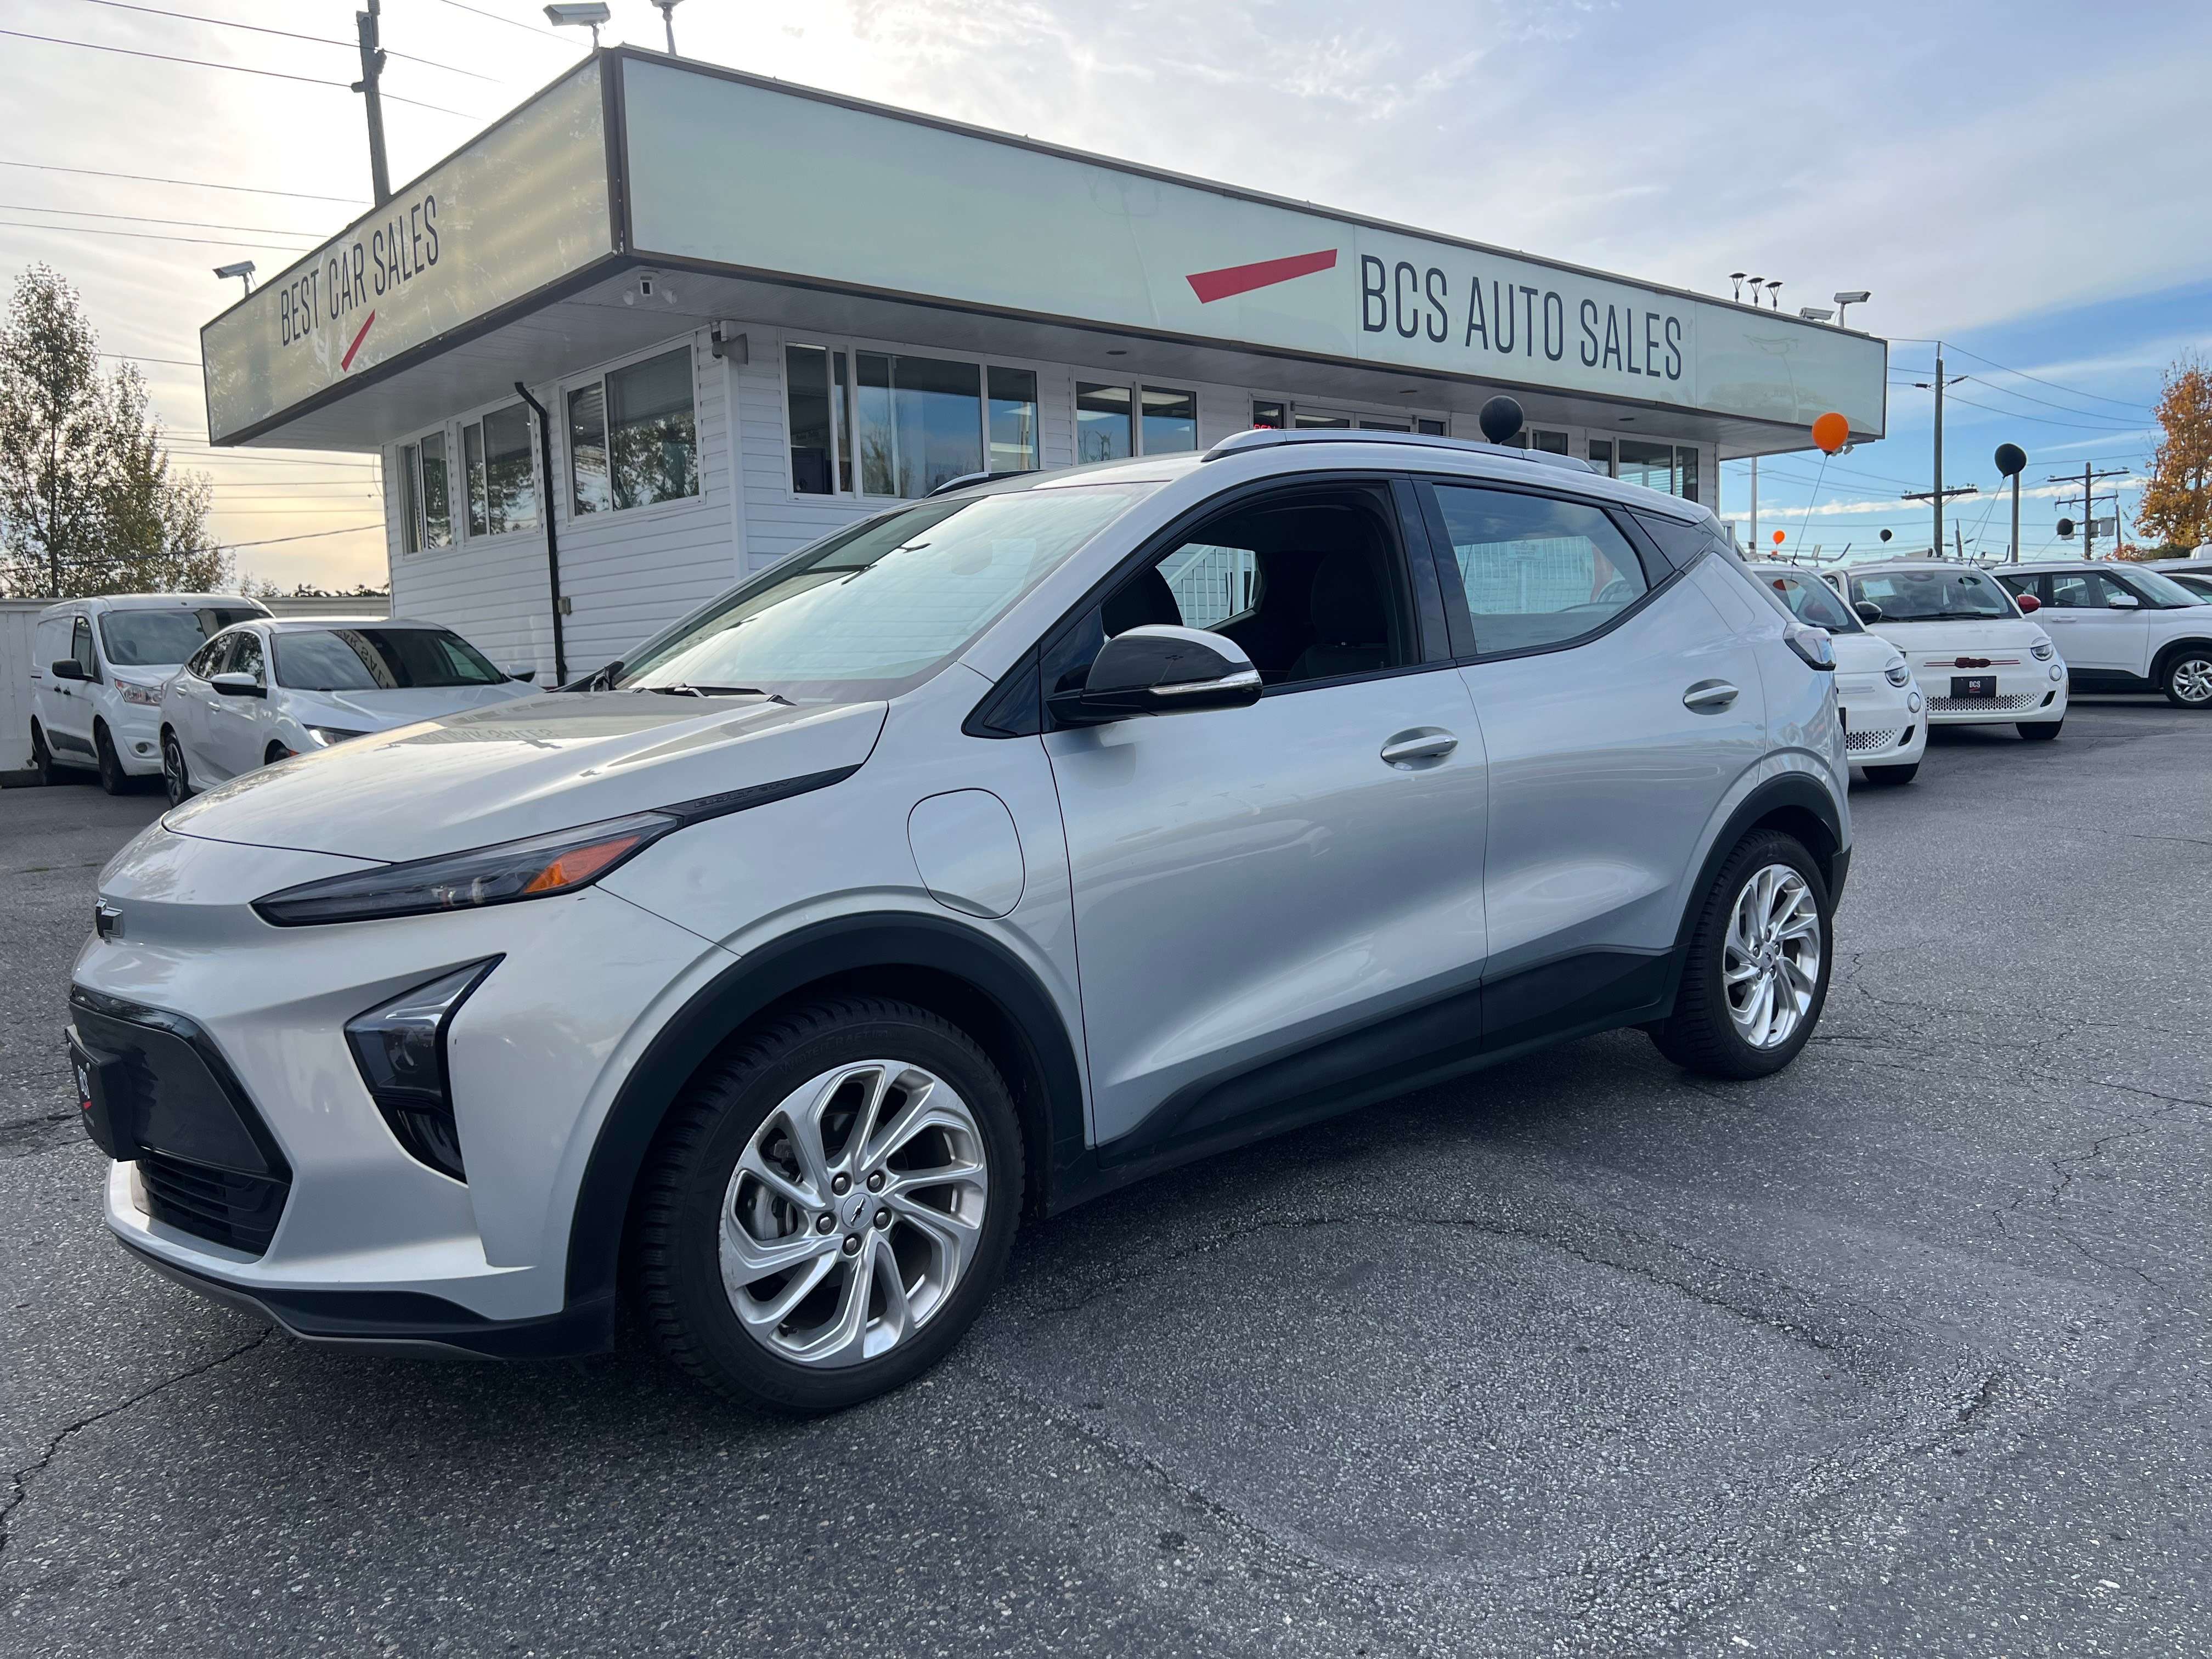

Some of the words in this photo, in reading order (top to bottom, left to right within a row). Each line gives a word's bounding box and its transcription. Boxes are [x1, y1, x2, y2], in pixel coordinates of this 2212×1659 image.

[281, 268, 319, 347] BEST
[329, 242, 367, 320] CAR
[373, 195, 439, 296] SALES
[1361, 254, 1448, 343] BCS
[1465, 276, 1564, 361] AUTO
[1580, 299, 1681, 380] SALES
